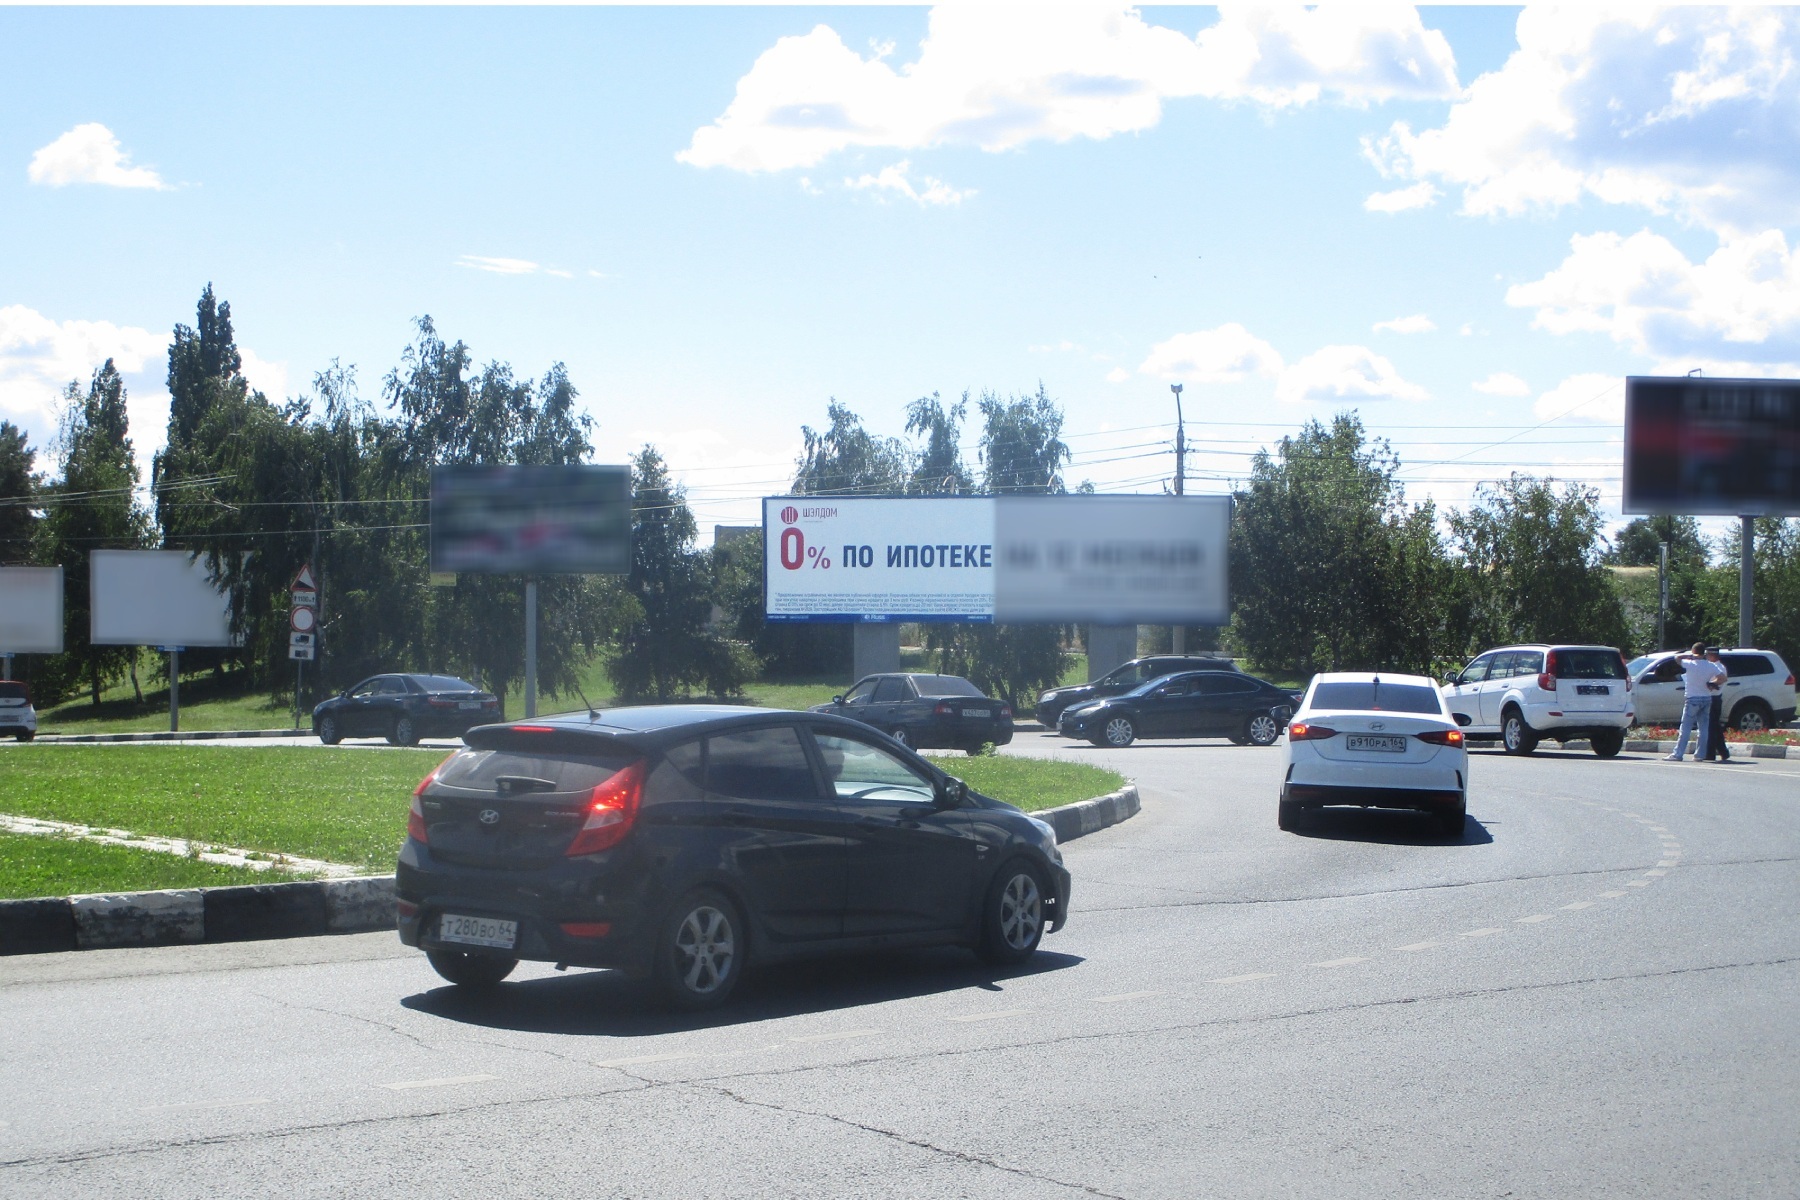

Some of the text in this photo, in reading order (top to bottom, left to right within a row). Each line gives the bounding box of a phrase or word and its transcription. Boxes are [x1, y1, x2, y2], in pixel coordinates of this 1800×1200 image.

[802, 507, 838, 519] ШЭЛДОМ
[843, 545, 874, 568] ПО
[887, 545, 992, 568] ИПОТЕКЕ
